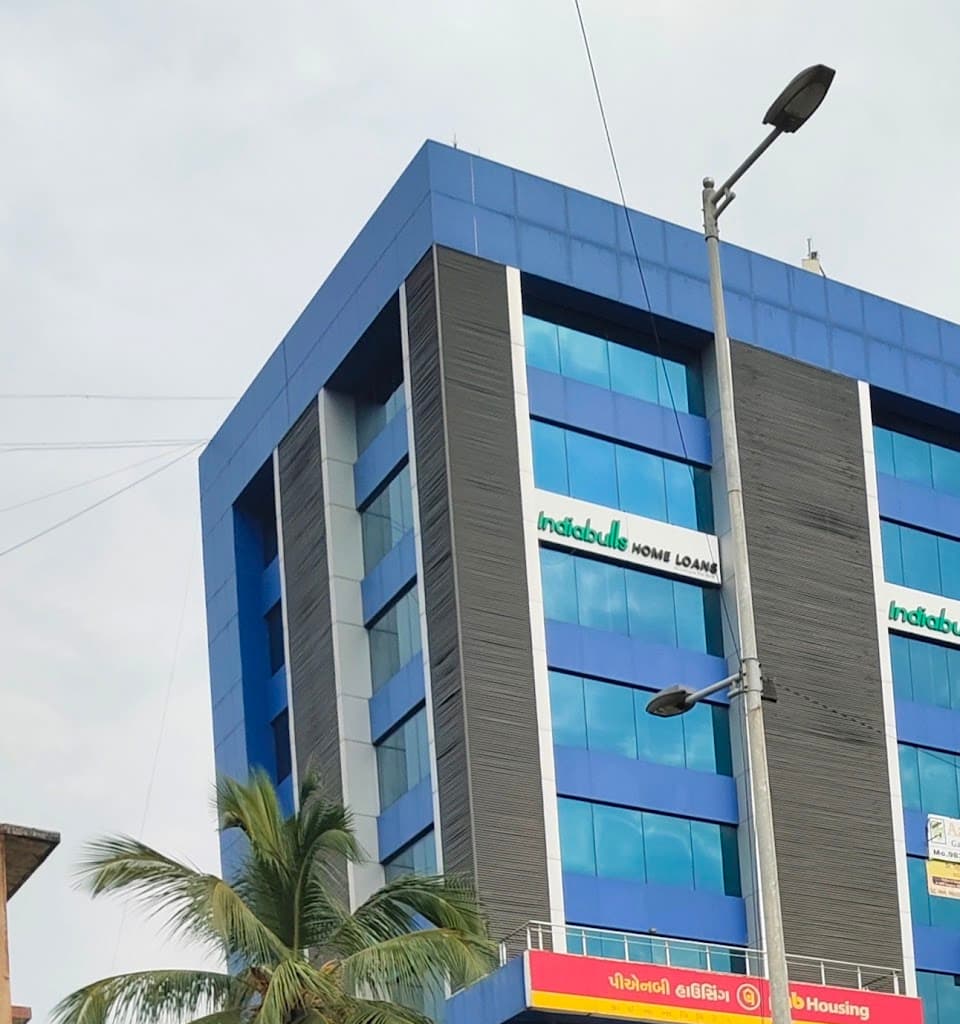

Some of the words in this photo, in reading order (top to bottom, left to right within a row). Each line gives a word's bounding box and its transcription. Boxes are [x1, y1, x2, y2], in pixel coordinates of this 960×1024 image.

[537, 511, 629, 552] Indiabulls
[631, 543, 671, 562] HOME
[675, 554, 719, 575] LOANS
[608, 972, 671, 996] પીએનબી
[674, 982, 731, 1003] હાઉસિંગ
[806, 996, 871, 1022] Housing
